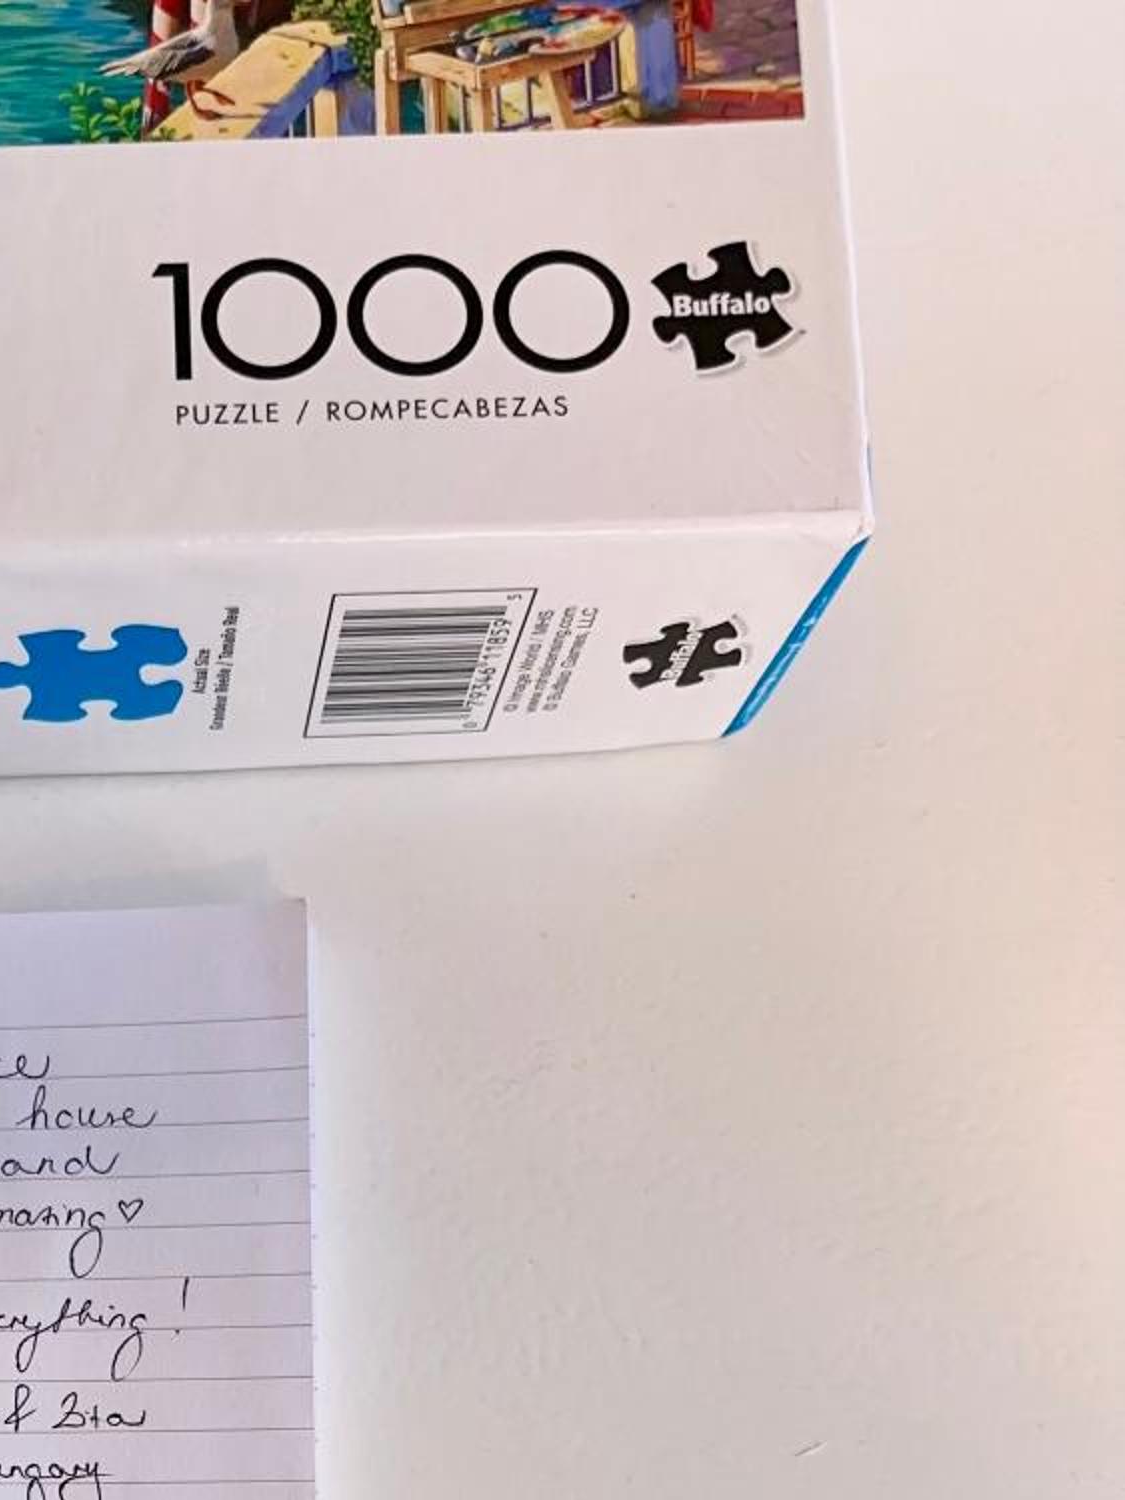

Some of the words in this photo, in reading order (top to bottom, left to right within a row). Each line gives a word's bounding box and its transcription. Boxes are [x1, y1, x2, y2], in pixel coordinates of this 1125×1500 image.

[151, 249, 630, 381] 1000
[674, 292, 771, 318] Buffalo
[175, 401, 280, 426] PUZZLE
[326, 395, 570, 422] ROMPECABEZAS
[16, 1085, 157, 1130] house
[0, 1145, 120, 1176] and
[5, 1384, 36, 1433] &
[52, 1392, 146, 1428] Zita
